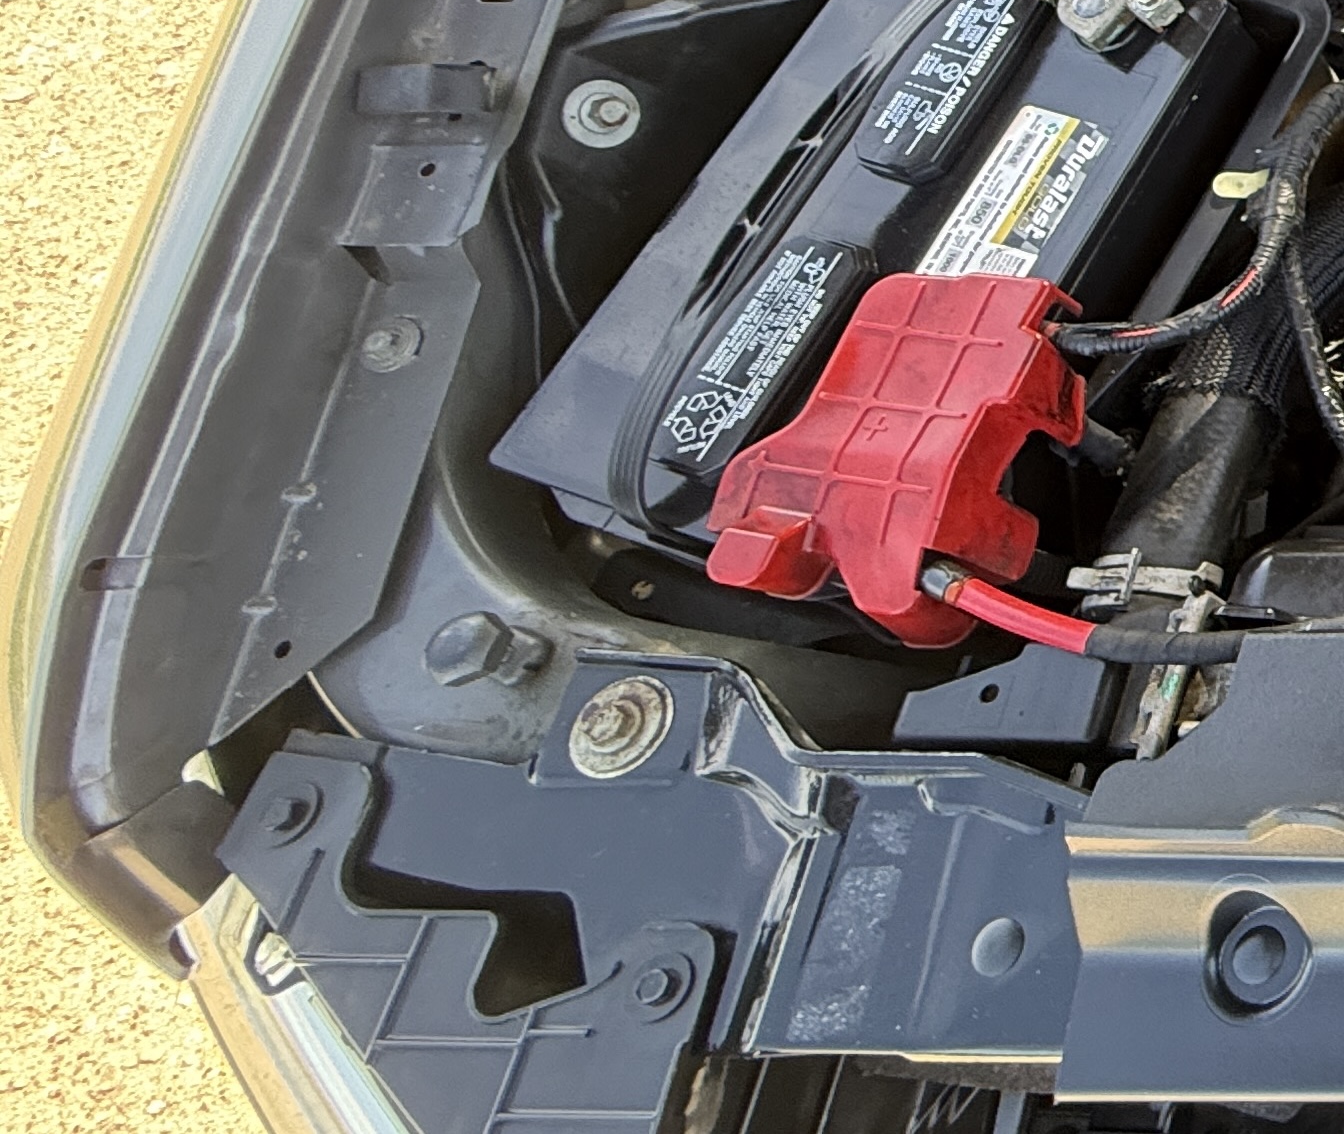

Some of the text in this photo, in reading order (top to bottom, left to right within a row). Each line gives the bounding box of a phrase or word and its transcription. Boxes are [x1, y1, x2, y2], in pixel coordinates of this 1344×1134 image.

[966, 24, 1008, 77] DANGER
[926, 84, 966, 135] POISON
[969, 200, 993, 224] 850
[1023, 134, 1105, 239] Duralast
